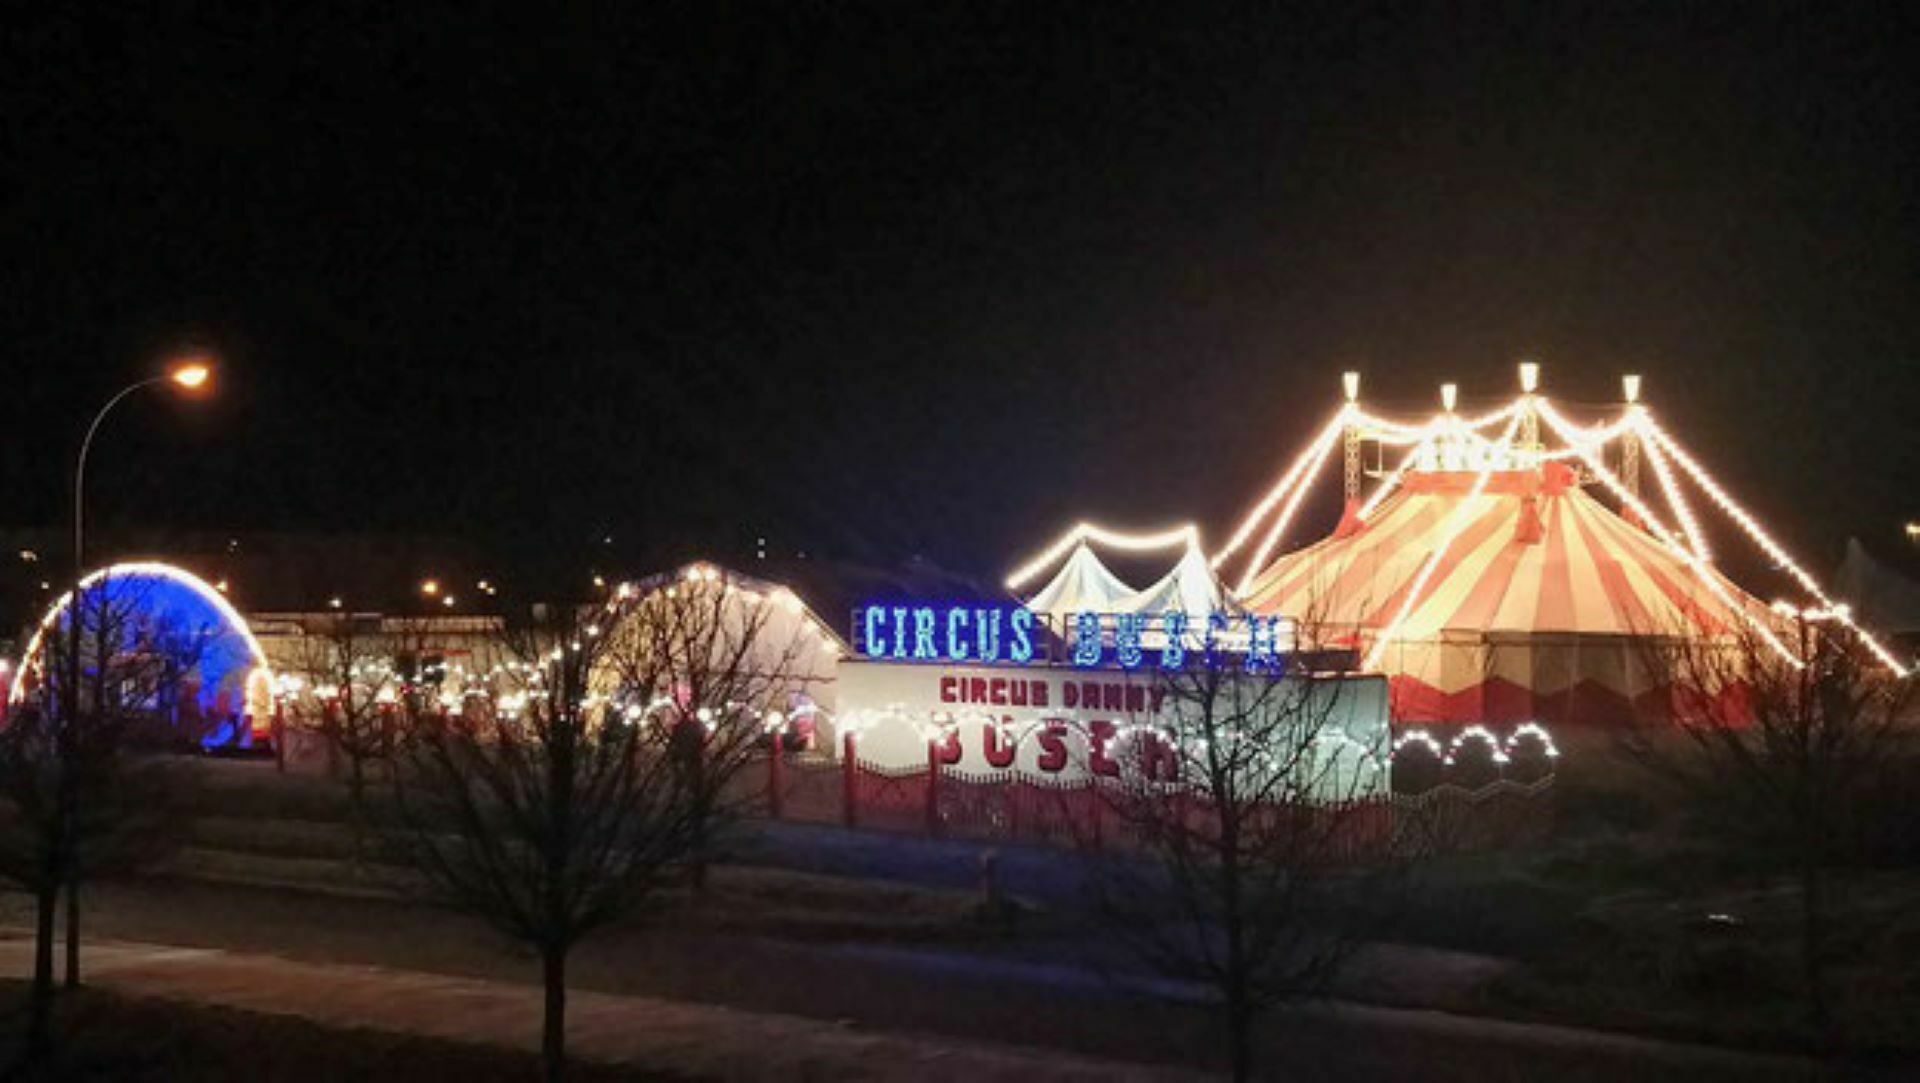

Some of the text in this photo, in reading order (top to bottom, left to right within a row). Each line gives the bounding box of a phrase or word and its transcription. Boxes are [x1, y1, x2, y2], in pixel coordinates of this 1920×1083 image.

[865, 605, 1034, 661] CIRCUS
[940, 677, 1167, 713] CIRCUS DANNY
